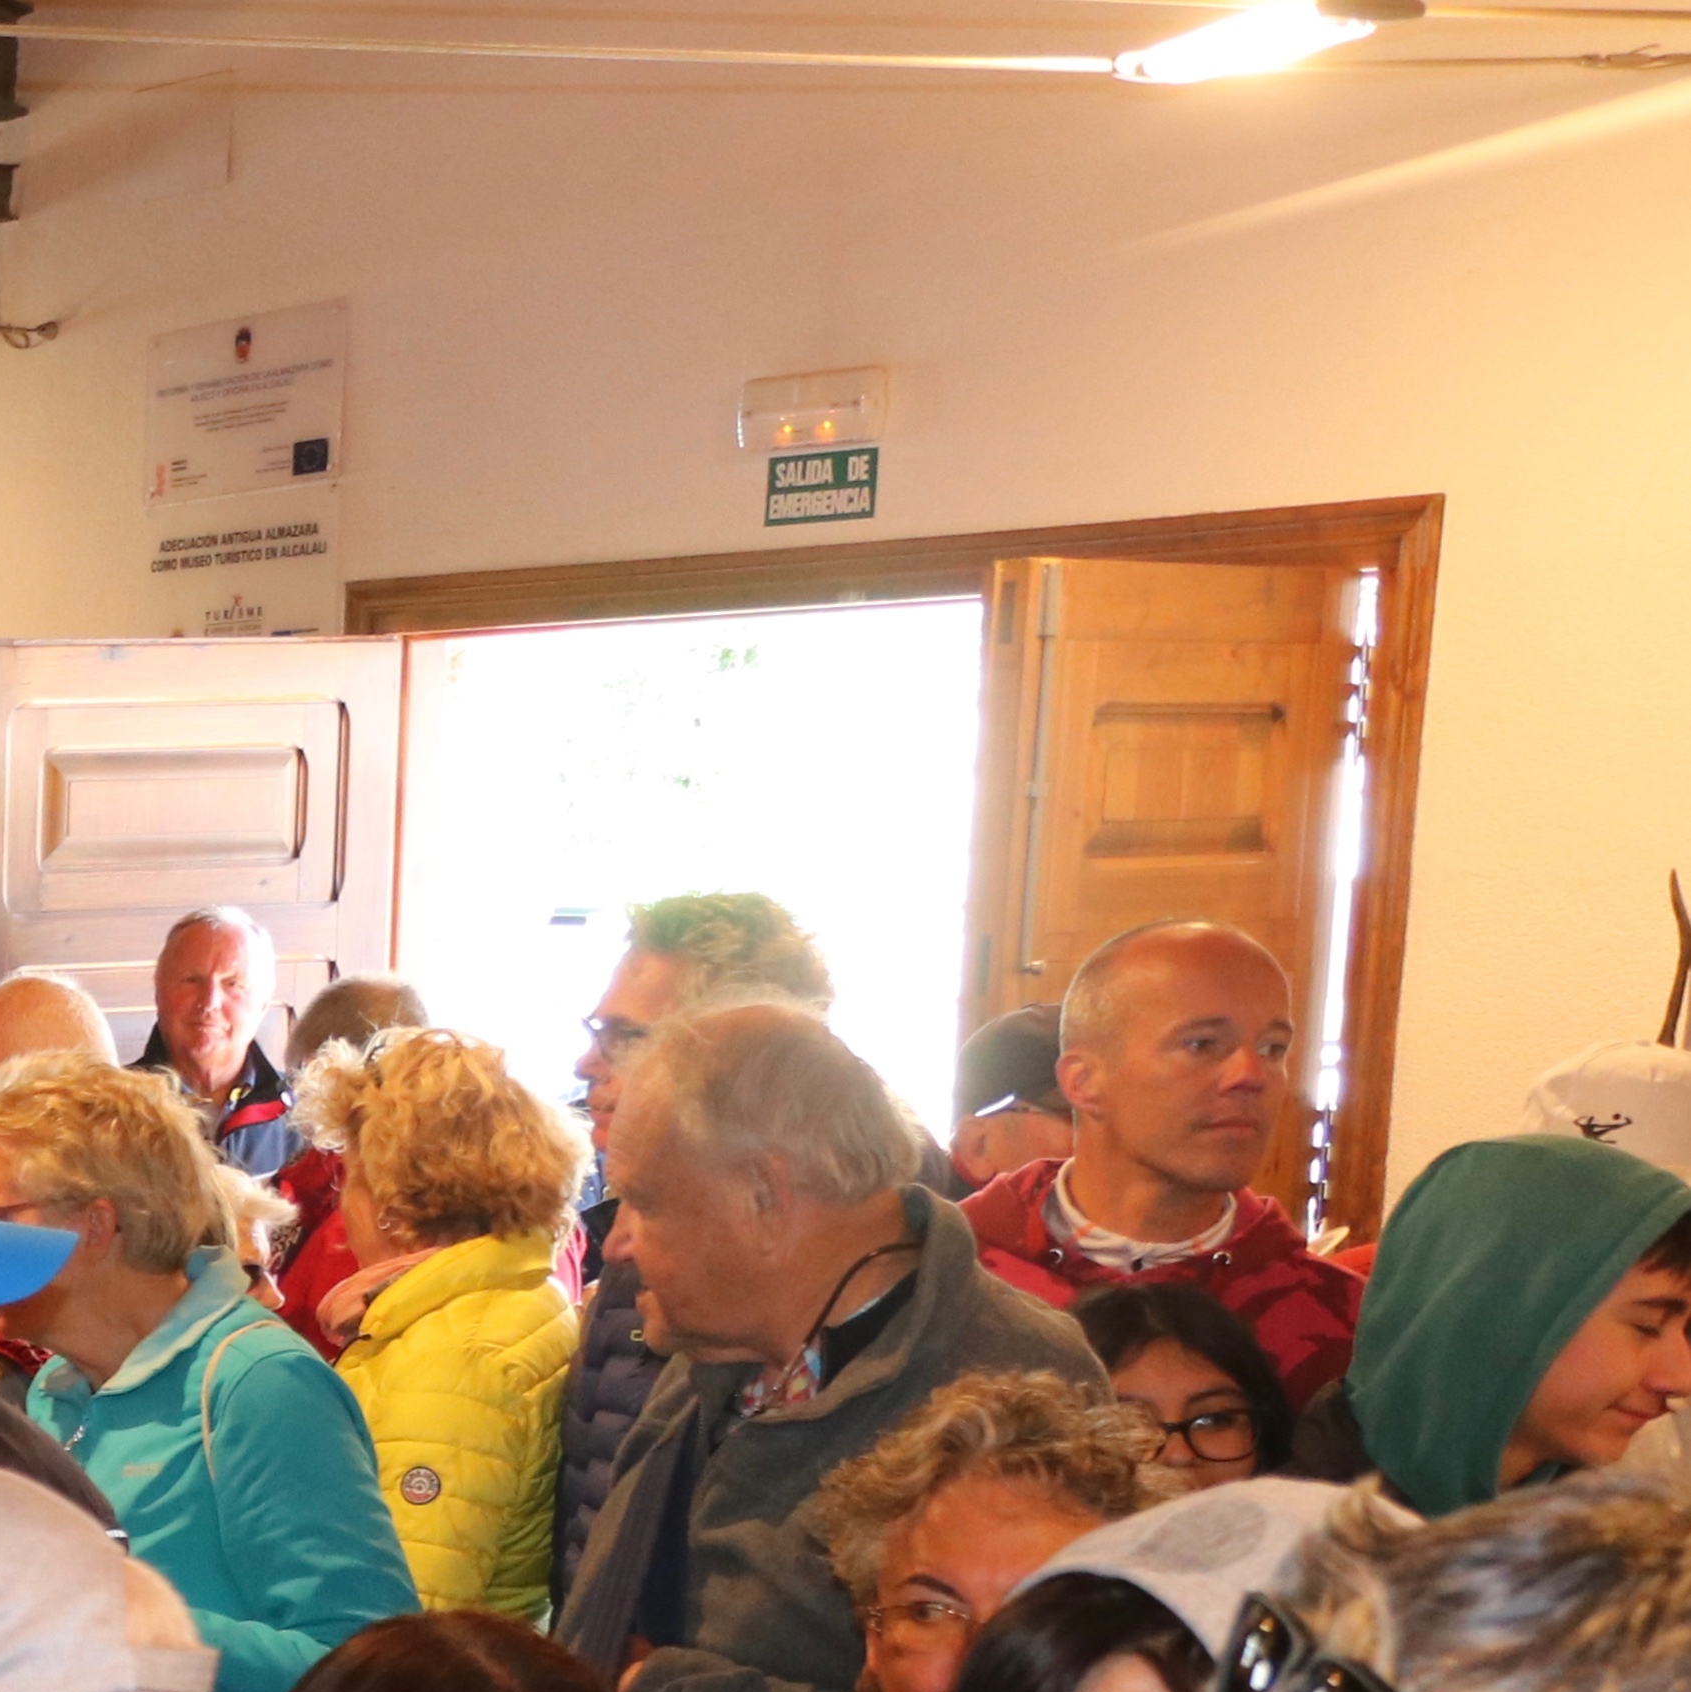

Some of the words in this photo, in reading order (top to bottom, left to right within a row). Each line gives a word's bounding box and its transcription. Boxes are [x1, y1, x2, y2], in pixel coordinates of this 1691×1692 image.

[775, 458, 834, 488] SALIDA
[847, 455, 870, 482] DE
[768, 486, 870, 520] EMERGENCIA
[221, 530, 262, 545] ANTIGUA
[265, 523, 319, 539] ALMAZARA
[151, 559, 177, 572] COMO
[180, 555, 212, 570] MUSEO
[265, 546, 278, 560] EN
